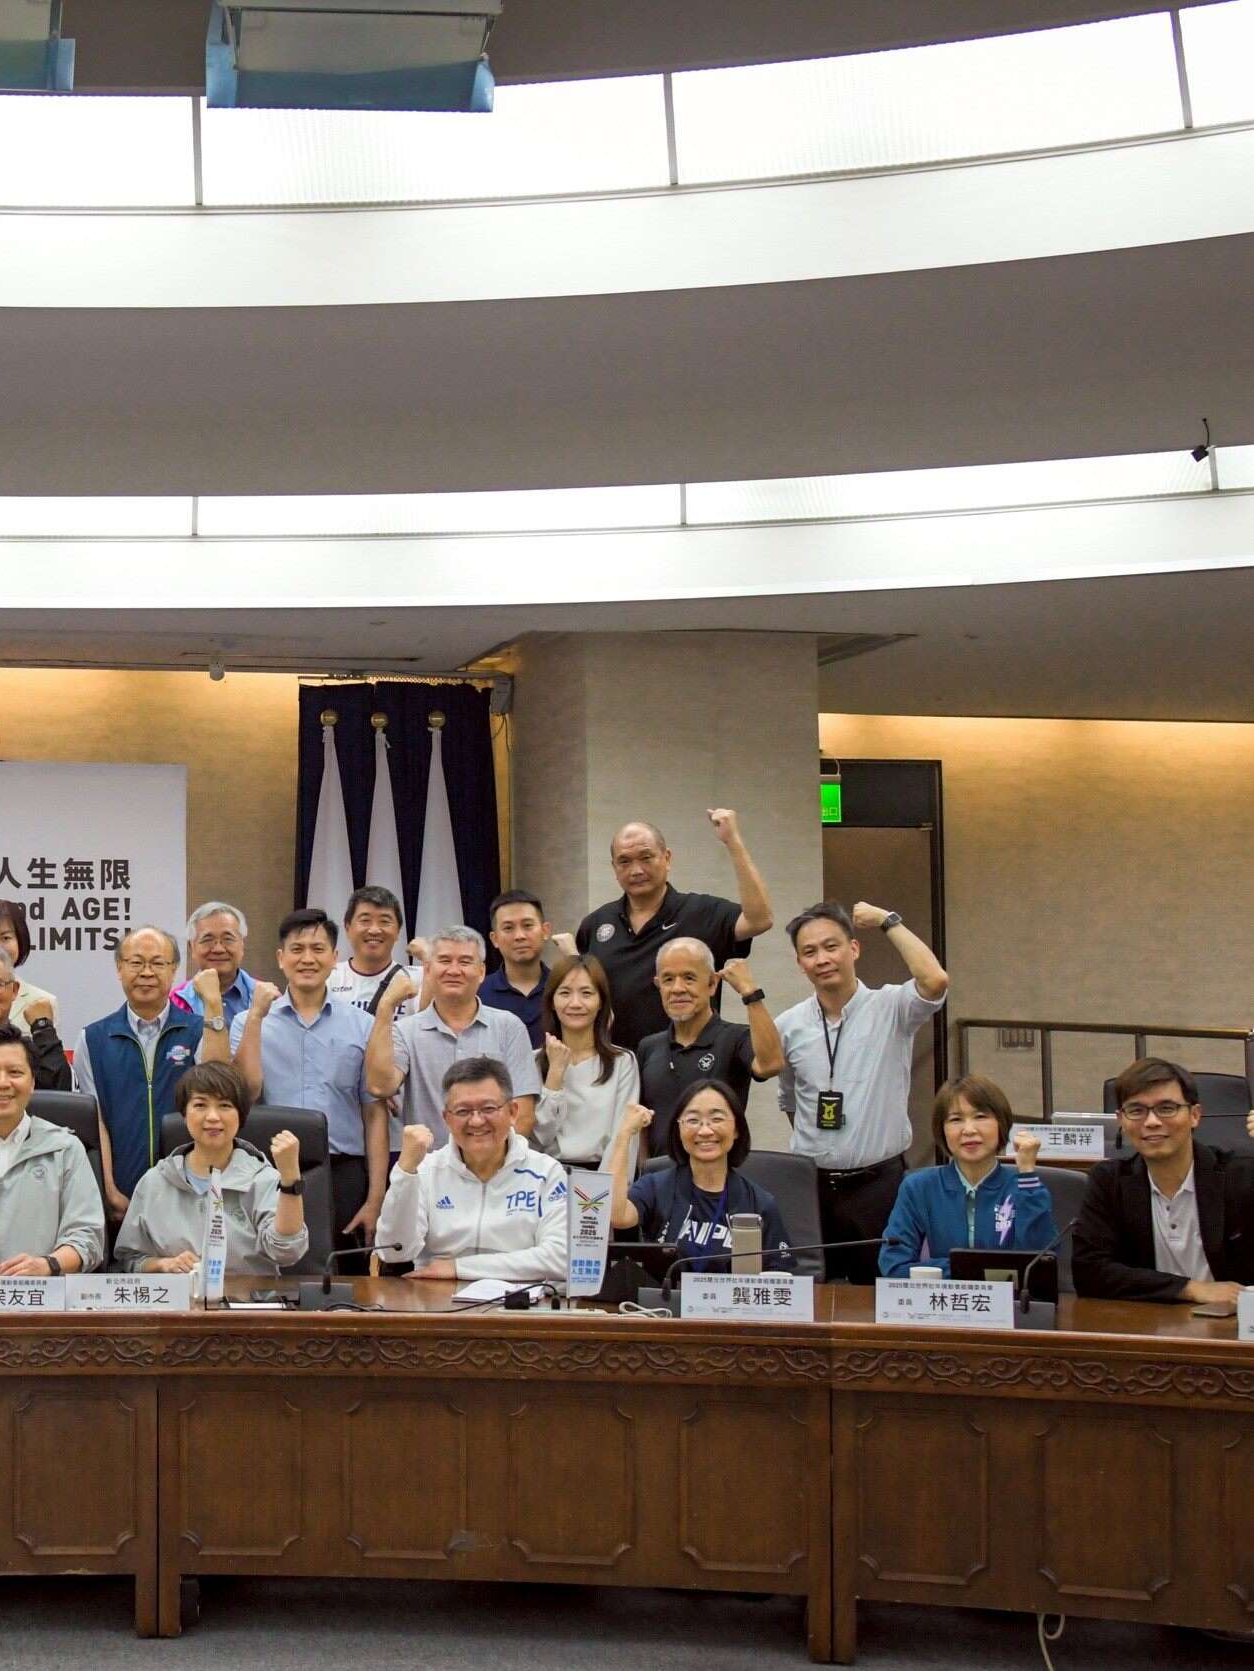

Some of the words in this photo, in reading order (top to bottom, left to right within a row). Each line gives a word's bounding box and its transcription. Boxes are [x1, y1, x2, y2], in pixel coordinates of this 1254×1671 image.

[61, 897, 131, 920] AGE!
[1049, 1132, 1093, 1146] 王麟祥
[506, 1190, 537, 1209] TPE
[114, 1286, 170, 1304] 朱惕之
[732, 1286, 792, 1306] 龔雅雯
[929, 1292, 991, 1312] 林哲宏
